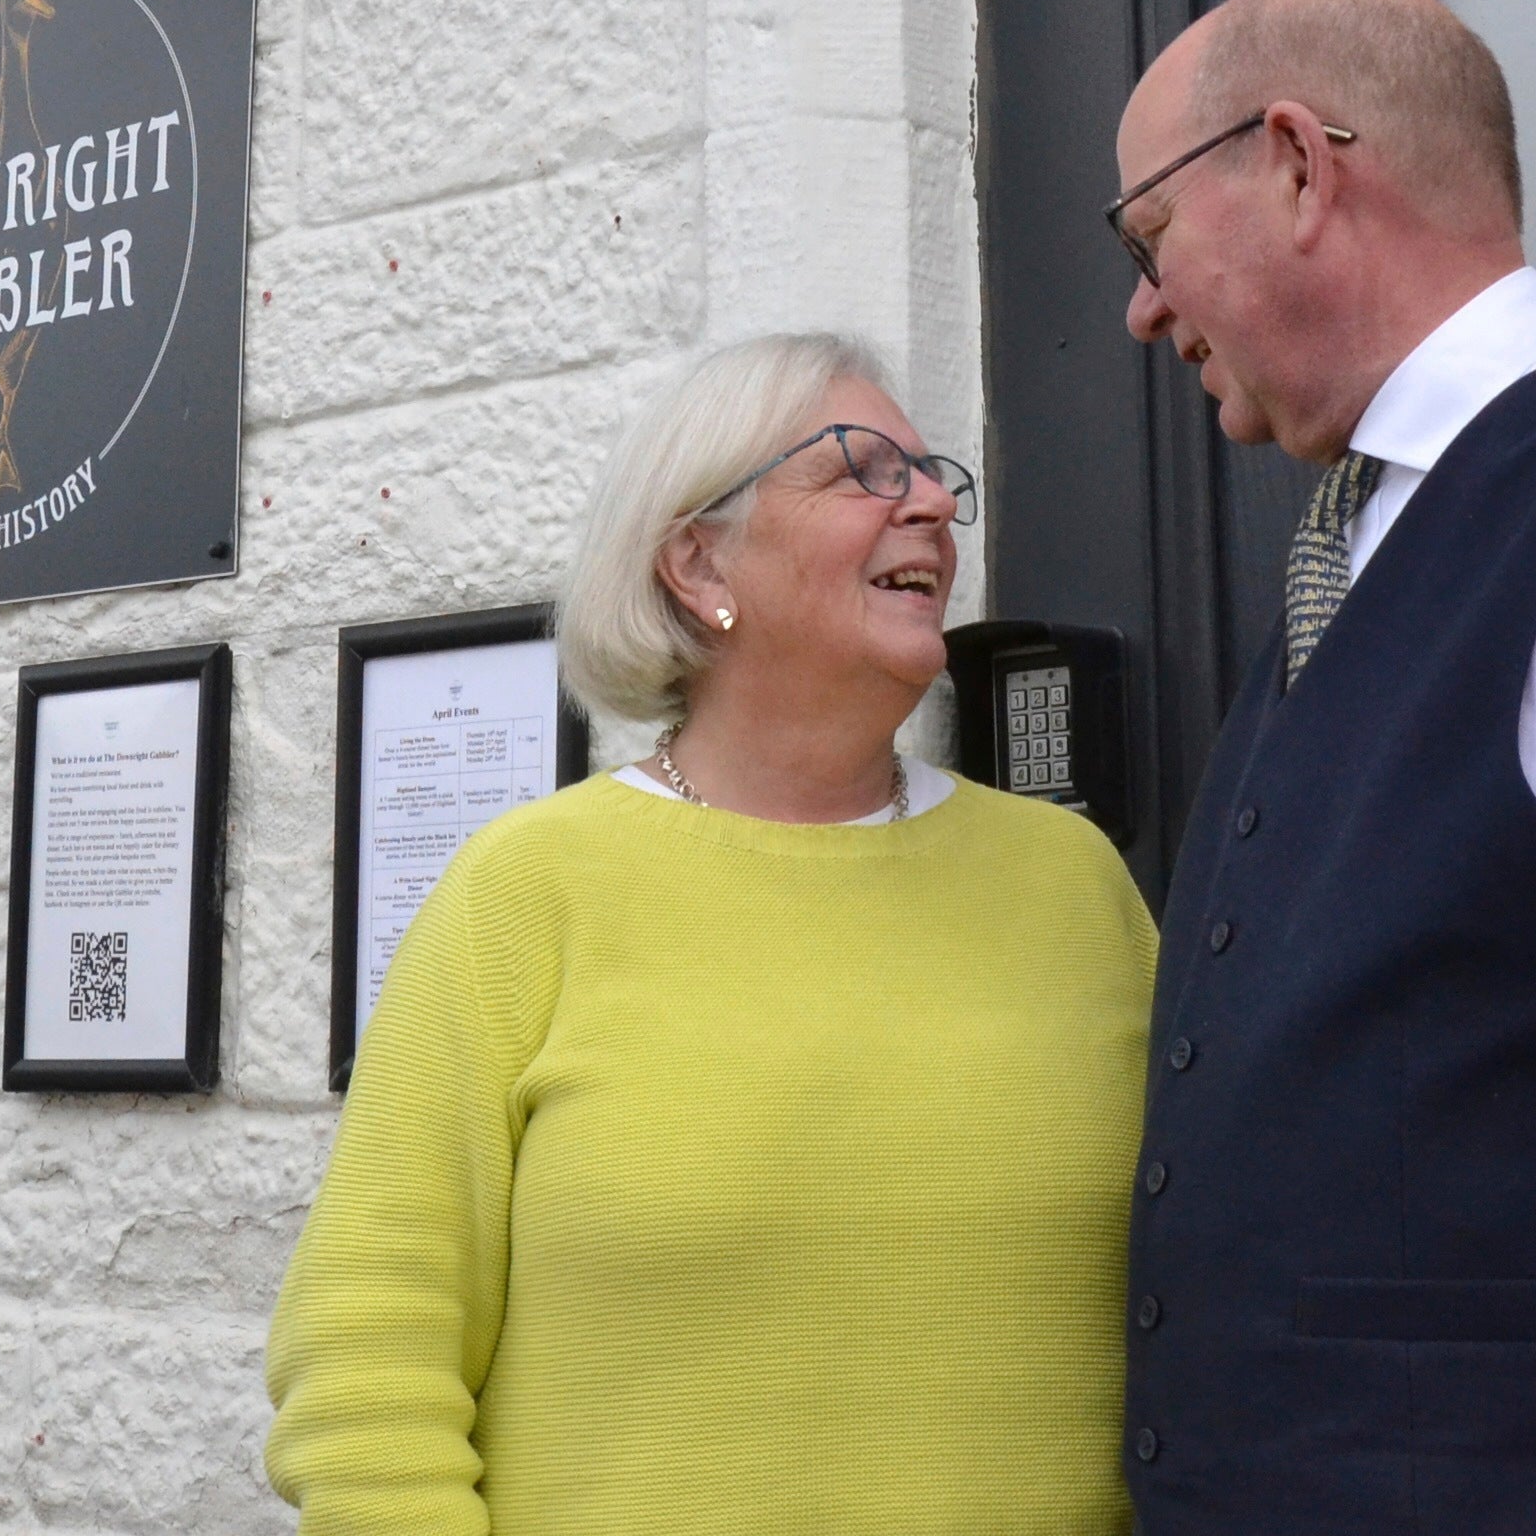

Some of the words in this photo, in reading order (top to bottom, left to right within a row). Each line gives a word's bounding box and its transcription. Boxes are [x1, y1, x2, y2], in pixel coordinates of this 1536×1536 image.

[1015, 695, 1020, 707] 1
[1034, 692, 1042, 704] 2
[1054, 689, 1062, 702] 3
[432, 708, 452, 720] April
[454, 707, 480, 717] Events
[1014, 718, 1022, 729] 4
[1035, 717, 1042, 729] 5
[1055, 715, 1063, 727] 6
[1015, 744, 1023, 756] 7
[1036, 741, 1043, 754] 8
[1056, 740, 1063, 753] 9
